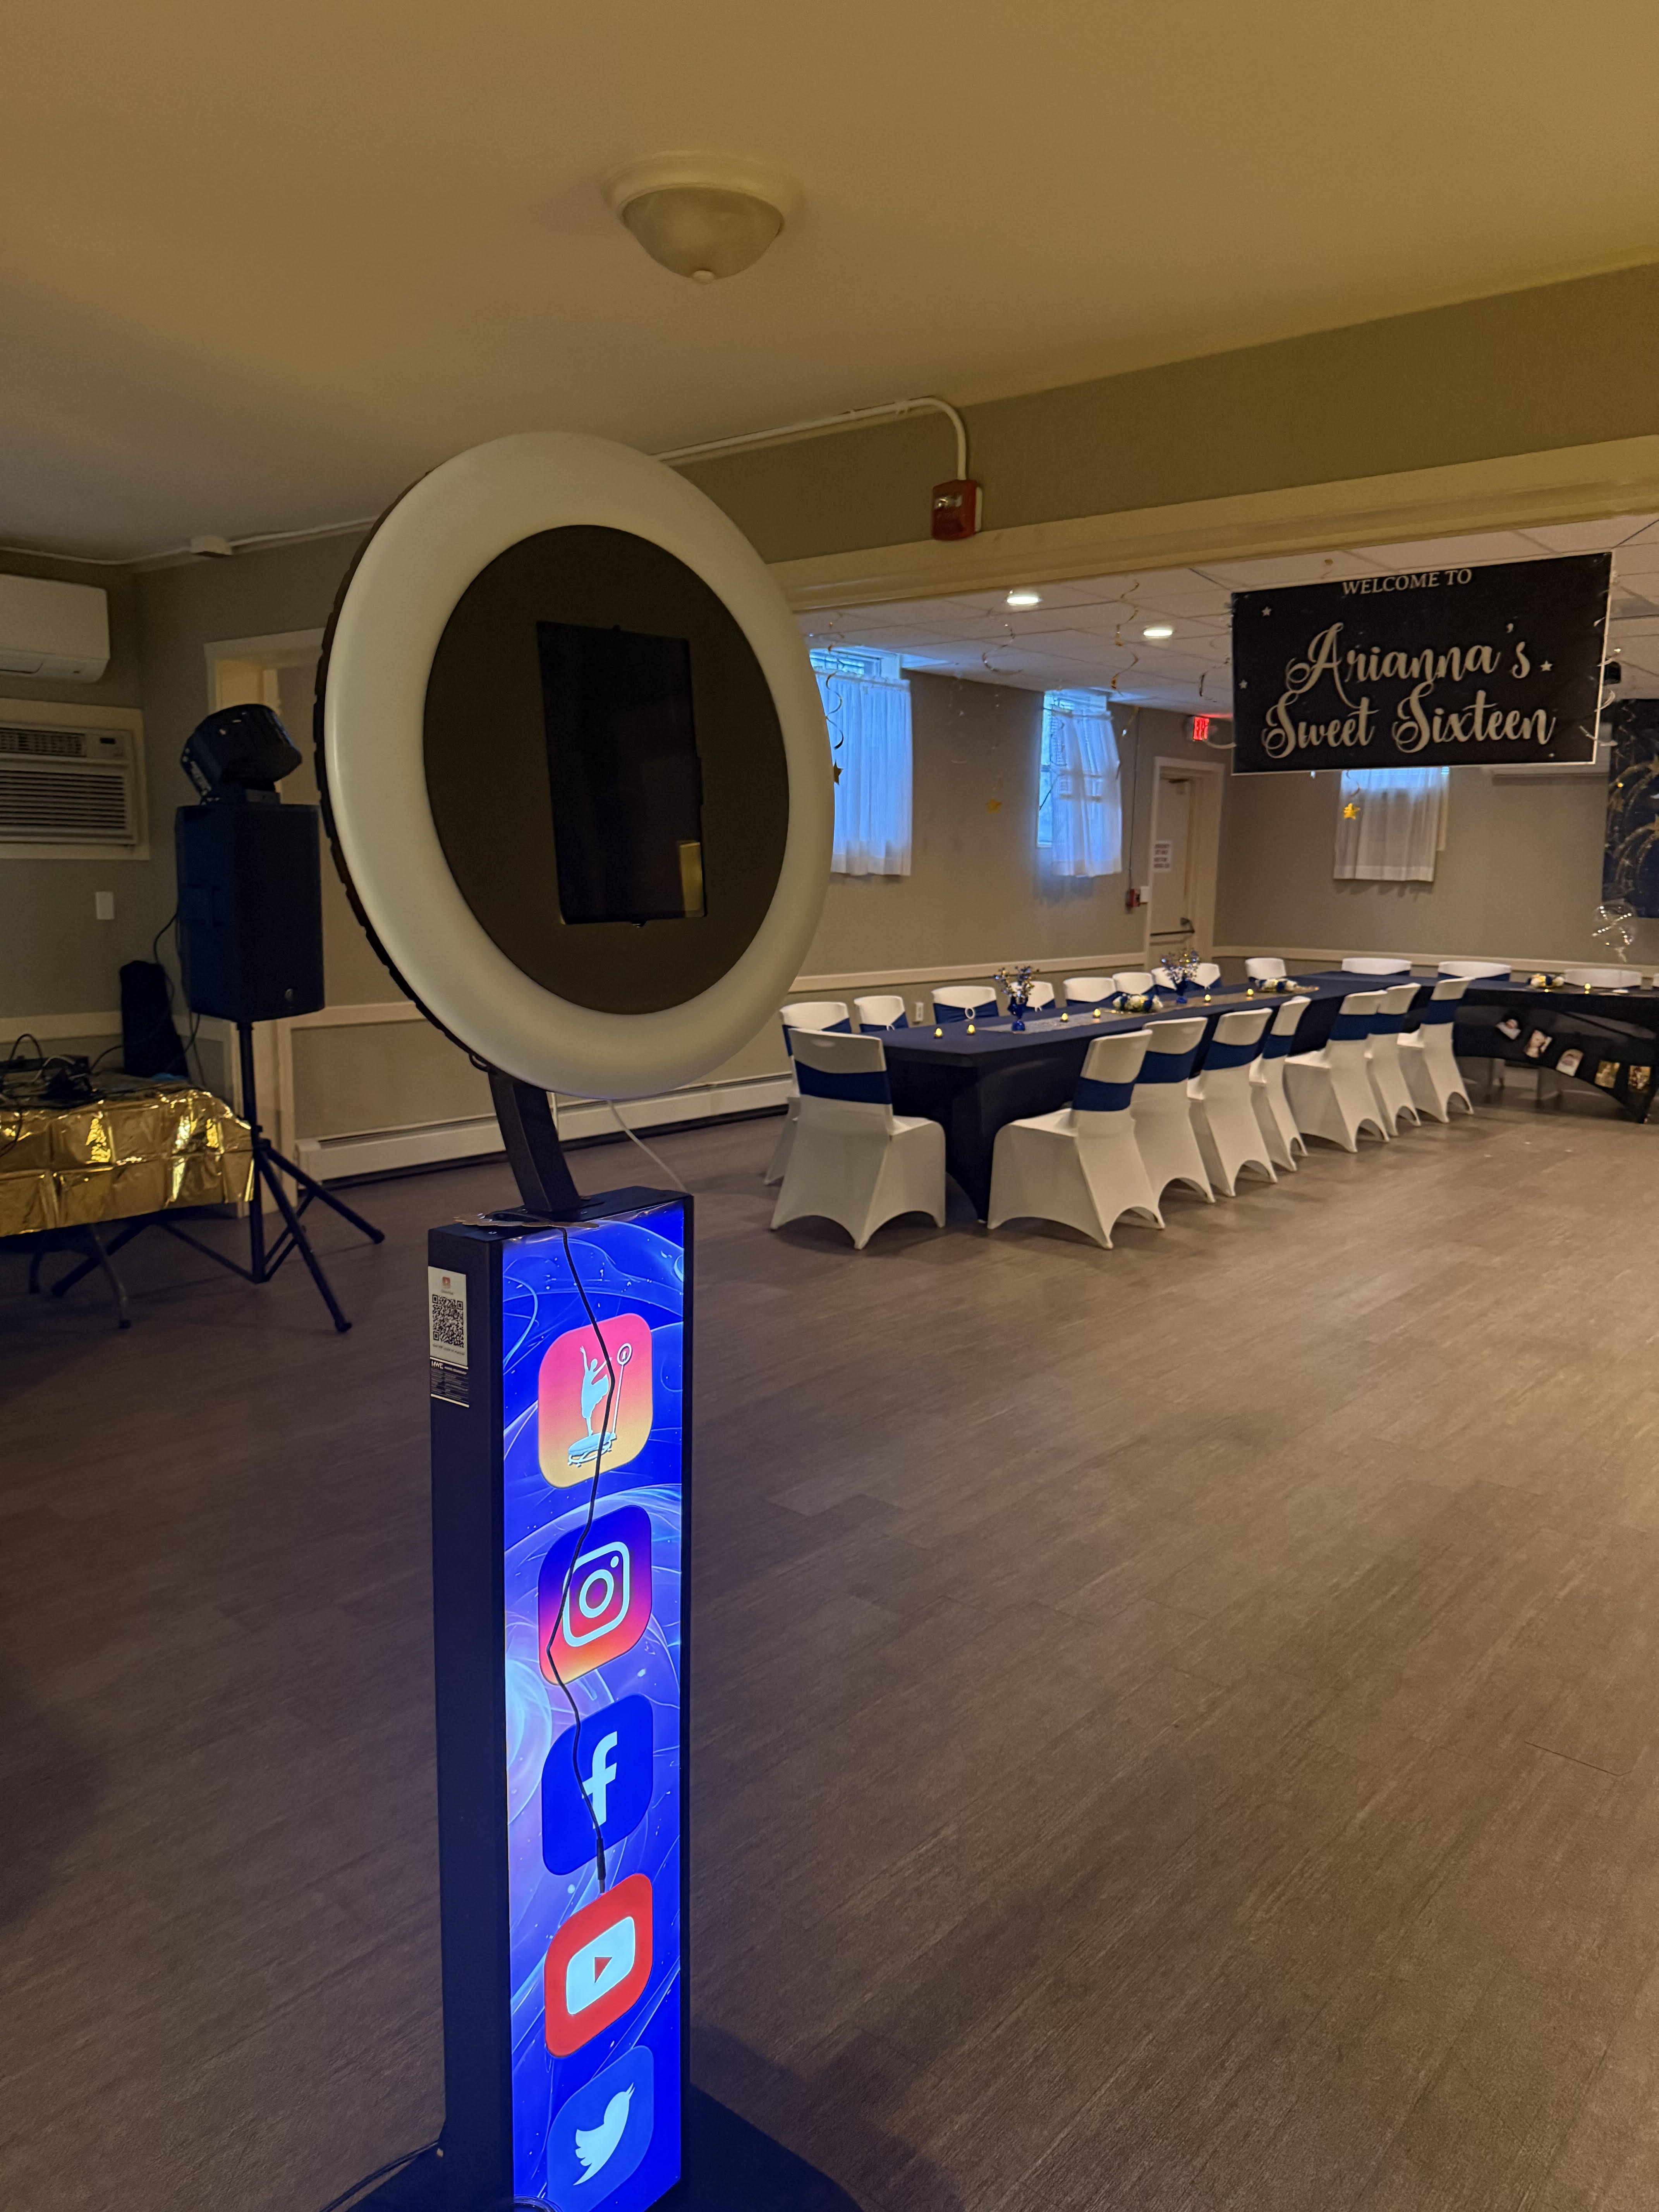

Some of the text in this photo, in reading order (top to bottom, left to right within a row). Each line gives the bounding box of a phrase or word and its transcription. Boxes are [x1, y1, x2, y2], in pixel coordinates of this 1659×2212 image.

[1342, 568, 1472, 595] WELCOME TO
[1286, 622, 1530, 709] Arianna's
[1262, 682, 1556, 759] Sweet Sixteen
